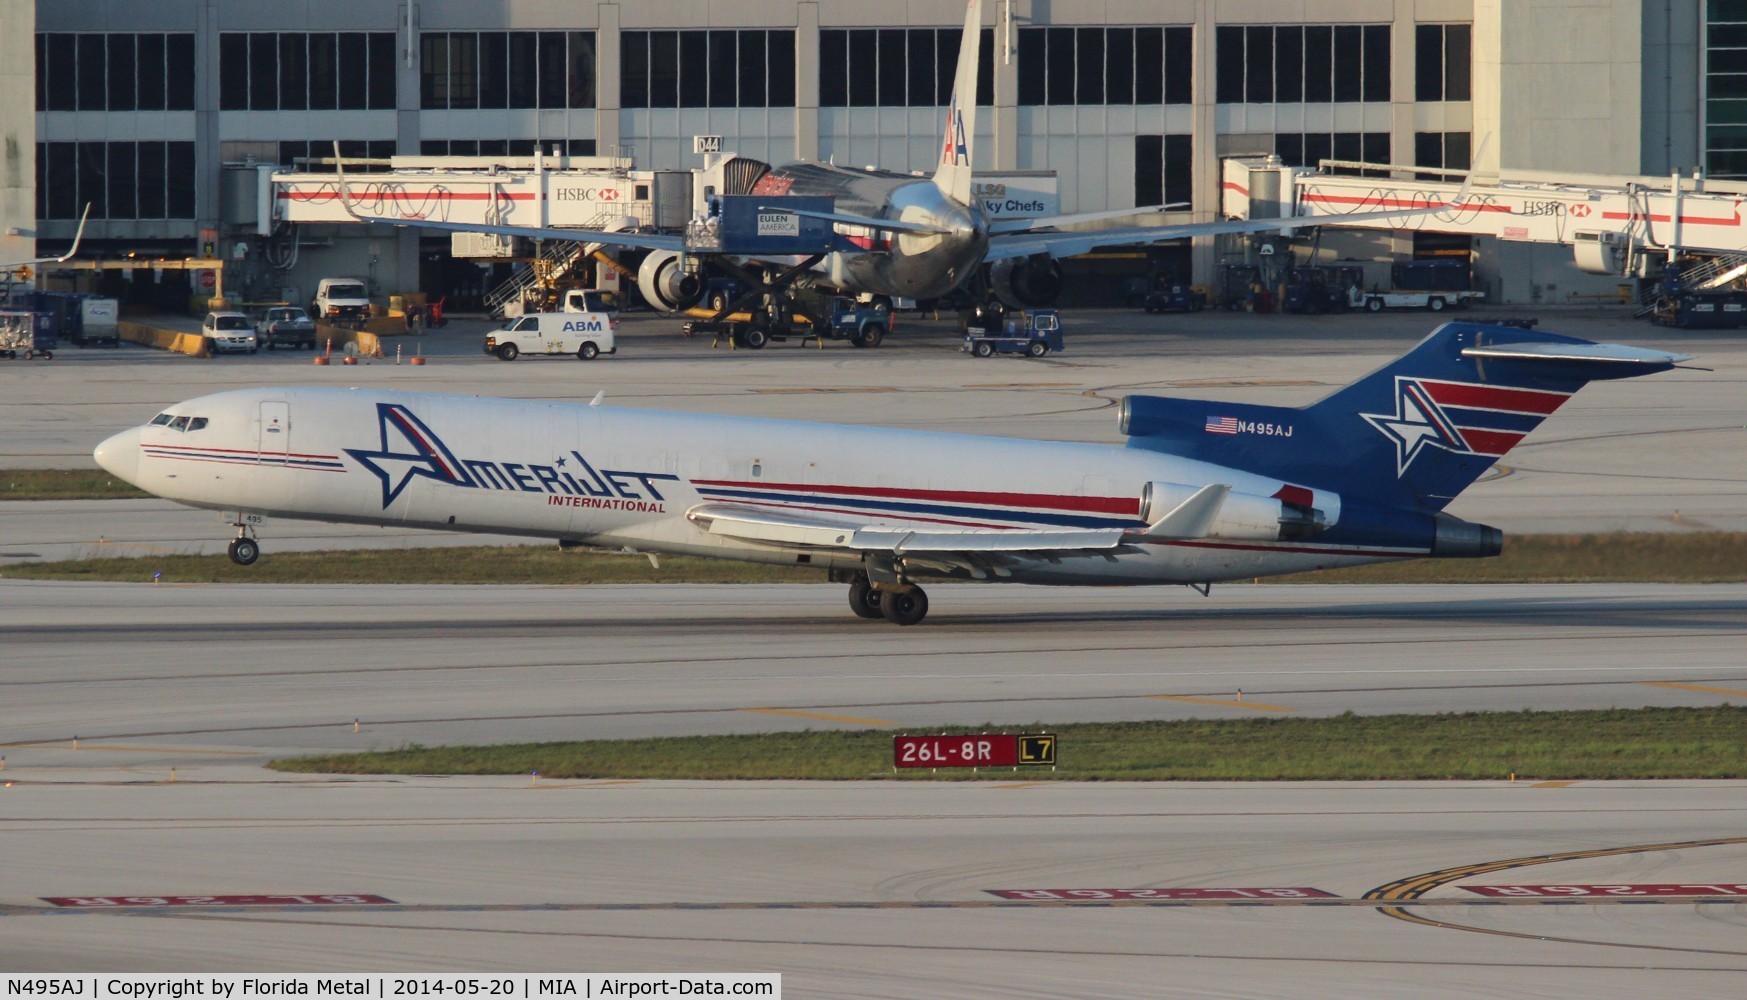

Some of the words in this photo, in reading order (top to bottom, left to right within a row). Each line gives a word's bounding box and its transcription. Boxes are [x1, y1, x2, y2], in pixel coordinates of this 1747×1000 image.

[698, 138, 719, 152] D44
[557, 188, 597, 201] HSBC
[976, 184, 1006, 195] LSG
[986, 201, 1002, 213] ky
[1005, 200, 1045, 212] Chefs
[1523, 201, 1566, 217] HSBC
[760, 215, 788, 223] EULEN
[760, 223, 796, 231] AMERICA
[563, 321, 602, 331] ABM
[1237, 421, 1293, 437] N495AJ
[548, 495, 666, 514] INTERNATIONAL
[246, 515, 262, 524] 495
[902, 741, 991, 762] 26L-8R
[1022, 740, 1051, 760] L7
[1485, 885, 1747, 896] L-26R
